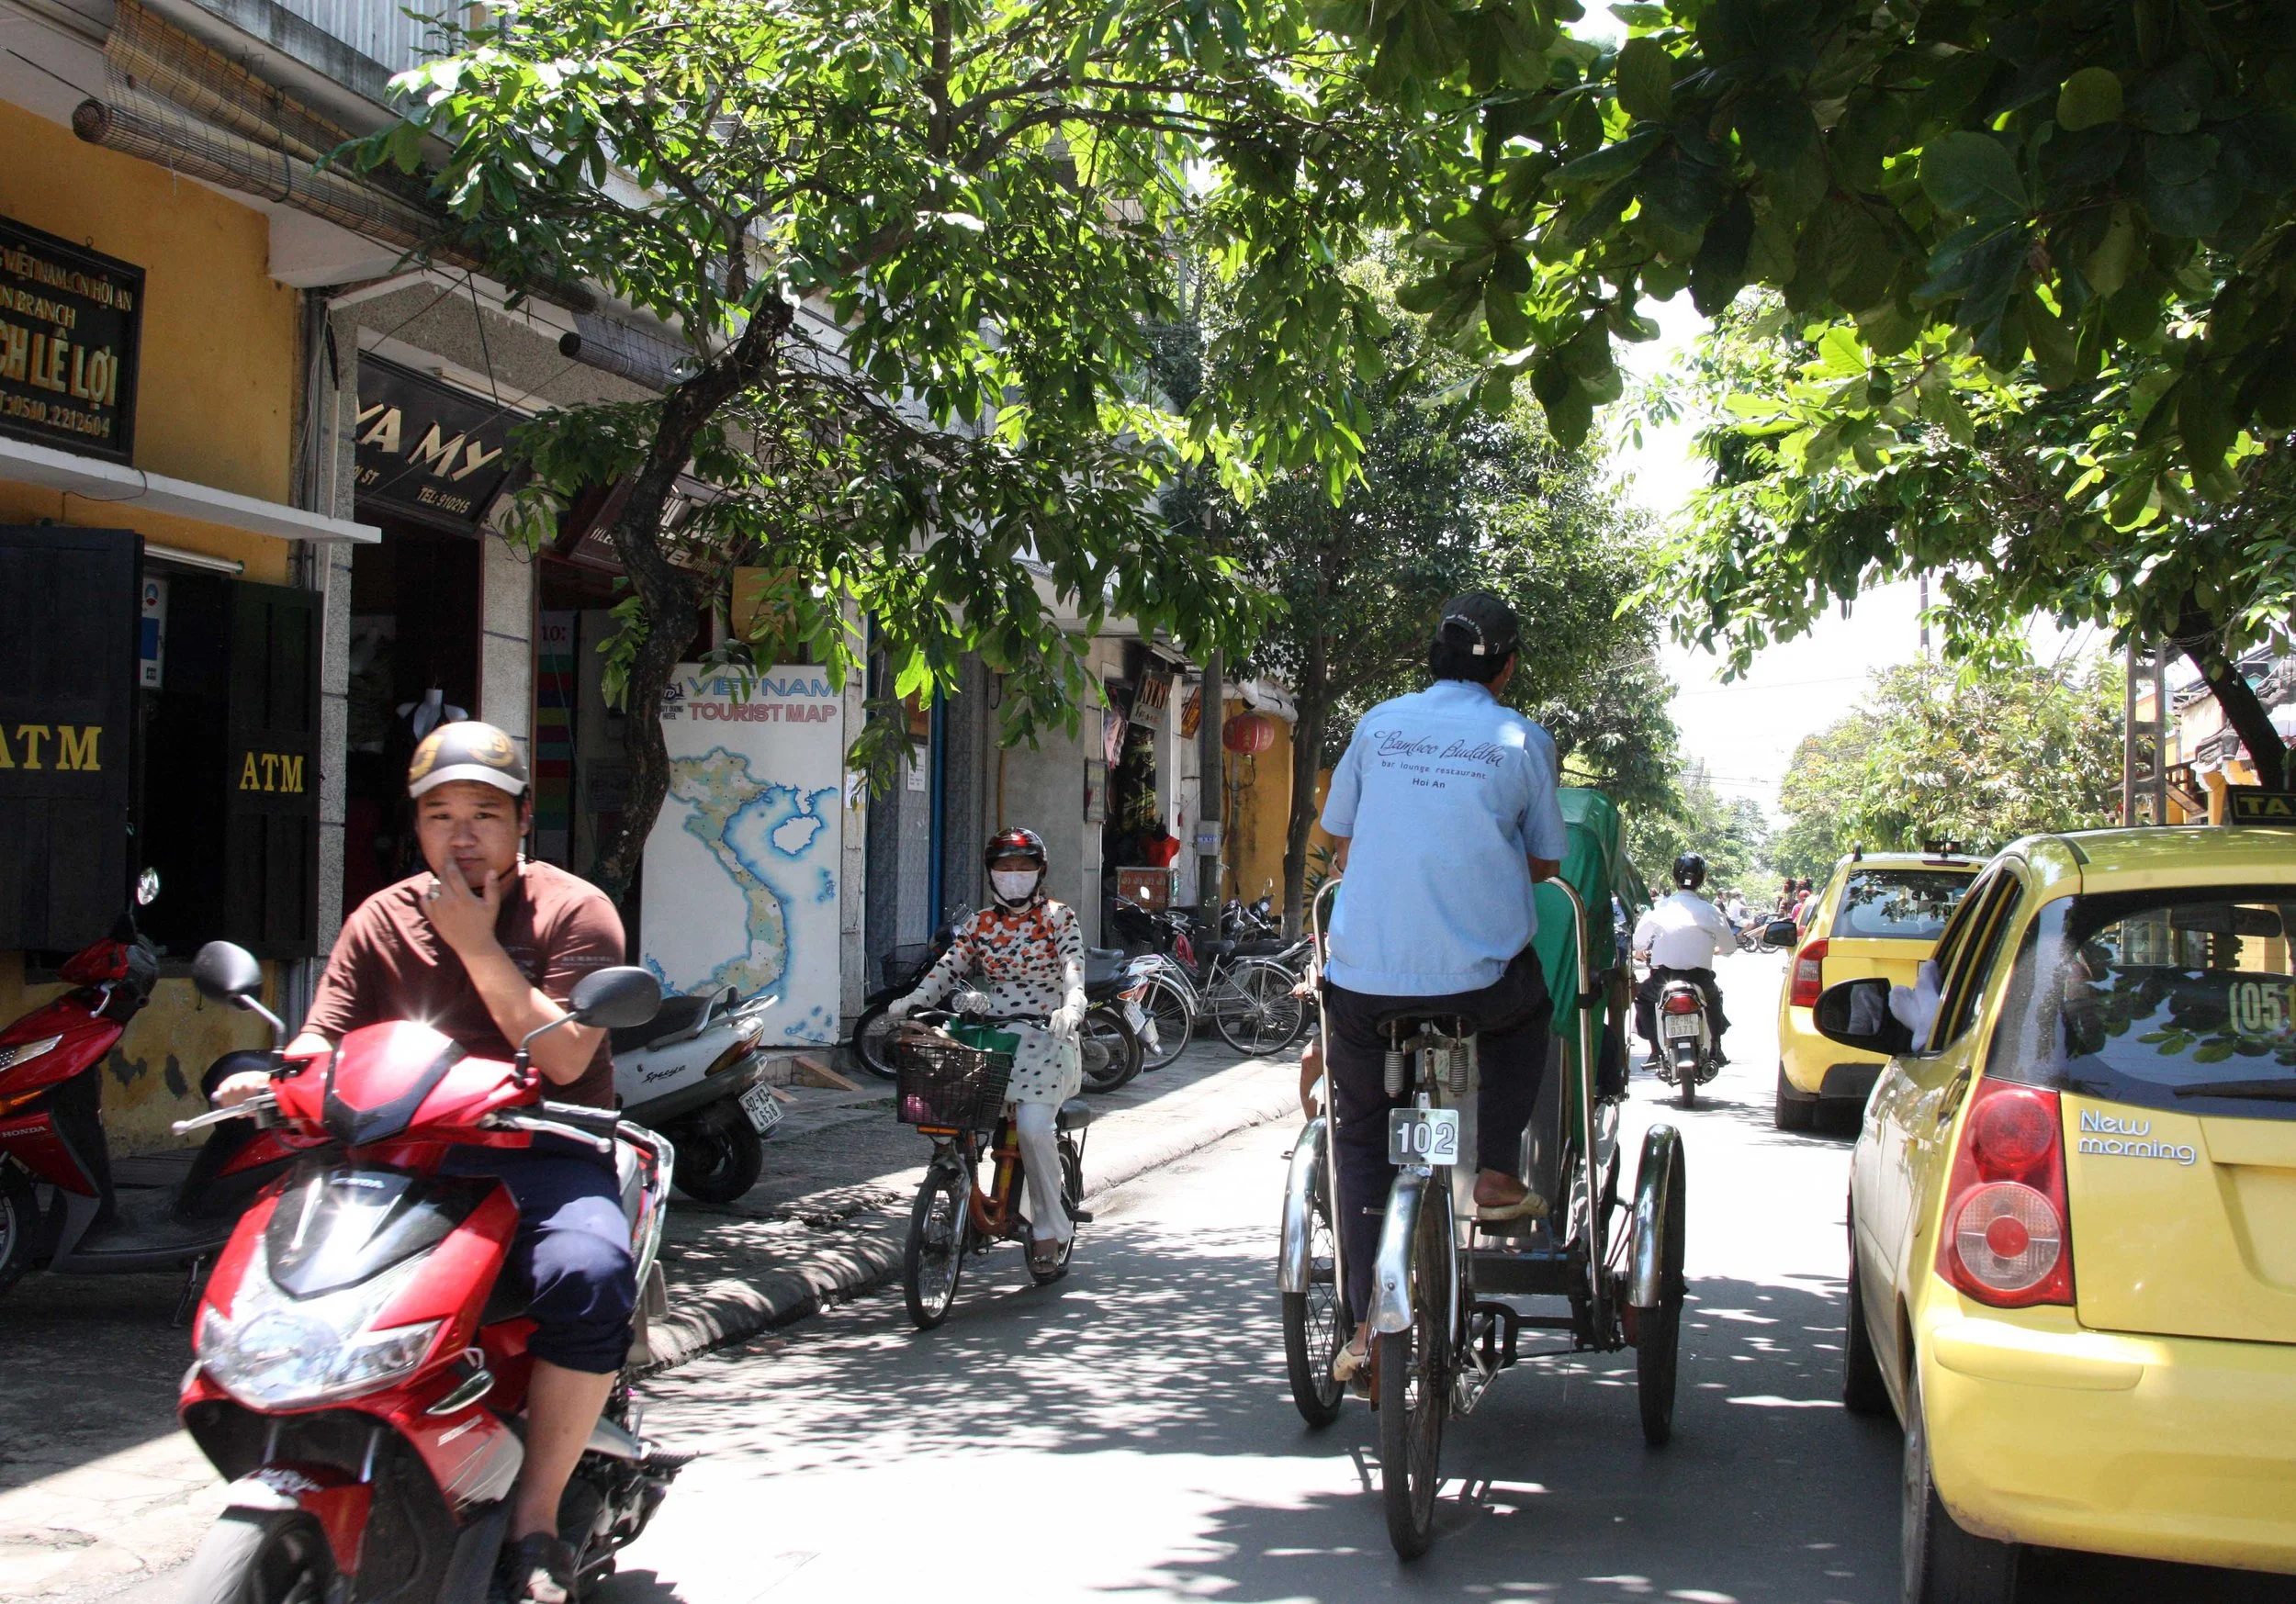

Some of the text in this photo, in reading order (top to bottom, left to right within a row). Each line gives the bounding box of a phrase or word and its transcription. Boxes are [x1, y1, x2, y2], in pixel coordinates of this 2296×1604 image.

[93, 272, 113, 309] HỘI
[115, 286, 132, 312] AN
[14, 289, 76, 330] BRANCH
[29, 326, 69, 393] LÊ
[70, 343, 118, 410] LỢI
[407, 421, 503, 483] MY
[362, 469, 380, 486] ST
[761, 678, 838, 697] NAM
[688, 701, 838, 723] TOURIST MAP
[1374, 731, 1505, 768] Bamboo Buddha
[239, 751, 304, 793] ATM
[1401, 762, 1430, 773] lounge
[1435, 767, 1487, 780] restaurant
[1412, 778, 1446, 789] Hoi An
[2239, 796, 2296, 816] TA
[2, 1126, 47, 1138] HONDA
[2080, 1108, 2151, 1137] New
[1396, 1121, 1456, 1155] 102
[2078, 1137, 2197, 1166] morning
